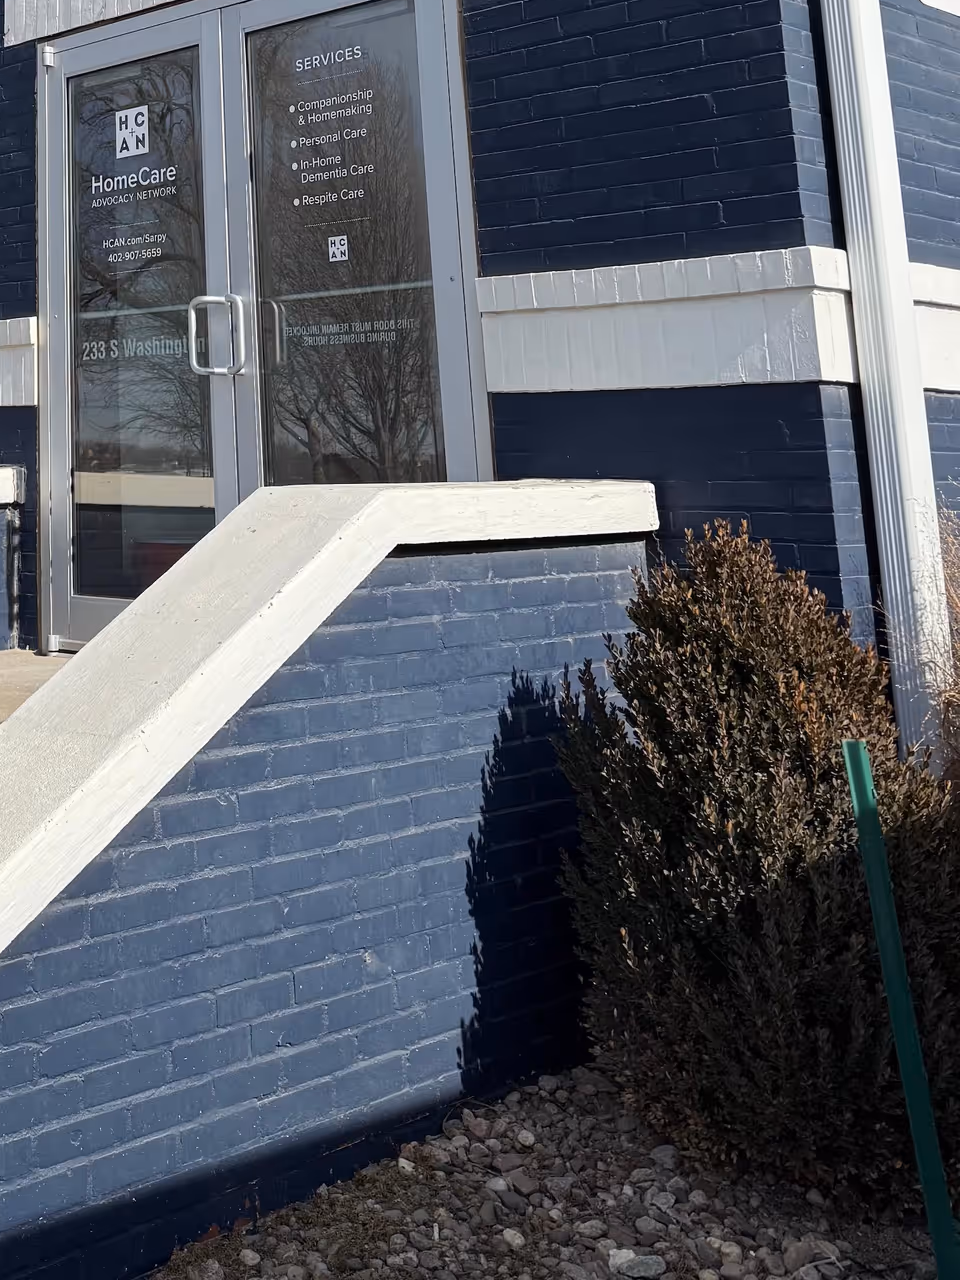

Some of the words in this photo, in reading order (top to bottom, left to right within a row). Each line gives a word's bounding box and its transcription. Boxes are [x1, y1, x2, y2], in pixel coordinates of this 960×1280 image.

[295, 45, 362, 72] SERVICES
[297, 88, 373, 112] Companionship
[298, 115, 306, 126] &
[308, 103, 373, 124] Homemaking
[299, 130, 341, 148] Personal
[343, 128, 367, 140] Care
[300, 155, 341, 170] In-Home
[91, 166, 177, 195] HomeCare
[301, 166, 348, 184] Dementia
[350, 164, 374, 175] Care
[91, 192, 134, 208] ADVOCACY
[136, 185, 177, 201] NETWORK
[302, 191, 338, 206] Respite
[340, 188, 364, 200] Care
[102, 232, 167, 249] HCAN.com/Sarpy
[108, 247, 162, 263] 402-907-5659
[82, 340, 106, 361] 233
[110, 339, 119, 358] S
[123, 335, 205, 358] Washingtn
